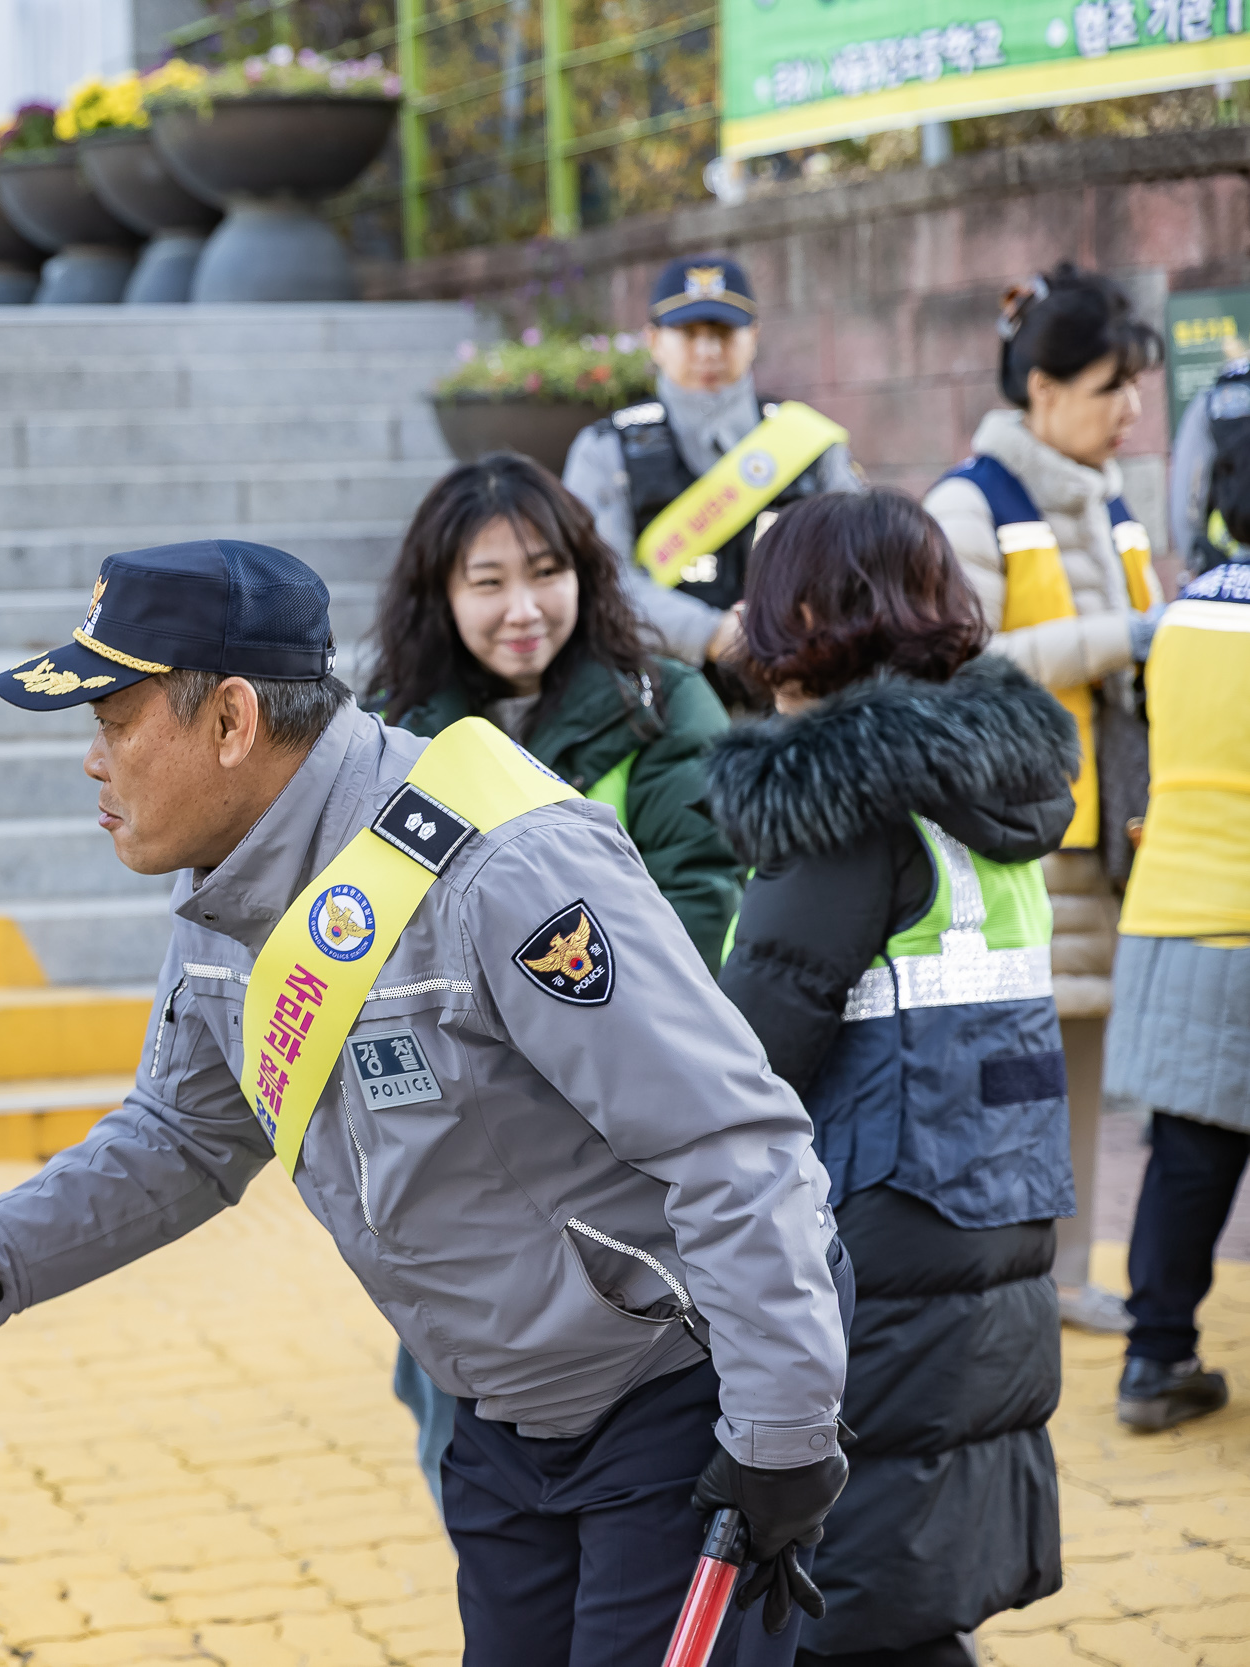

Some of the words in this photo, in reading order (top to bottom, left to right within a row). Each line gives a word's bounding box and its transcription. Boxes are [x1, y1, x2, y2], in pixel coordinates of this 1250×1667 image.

[573, 964, 606, 994] POLICE
[264, 963, 329, 1065] 주민과
[357, 1039, 421, 1076] 경찰
[256, 1049, 290, 1117] 함께
[370, 1076, 432, 1100] POLICE
